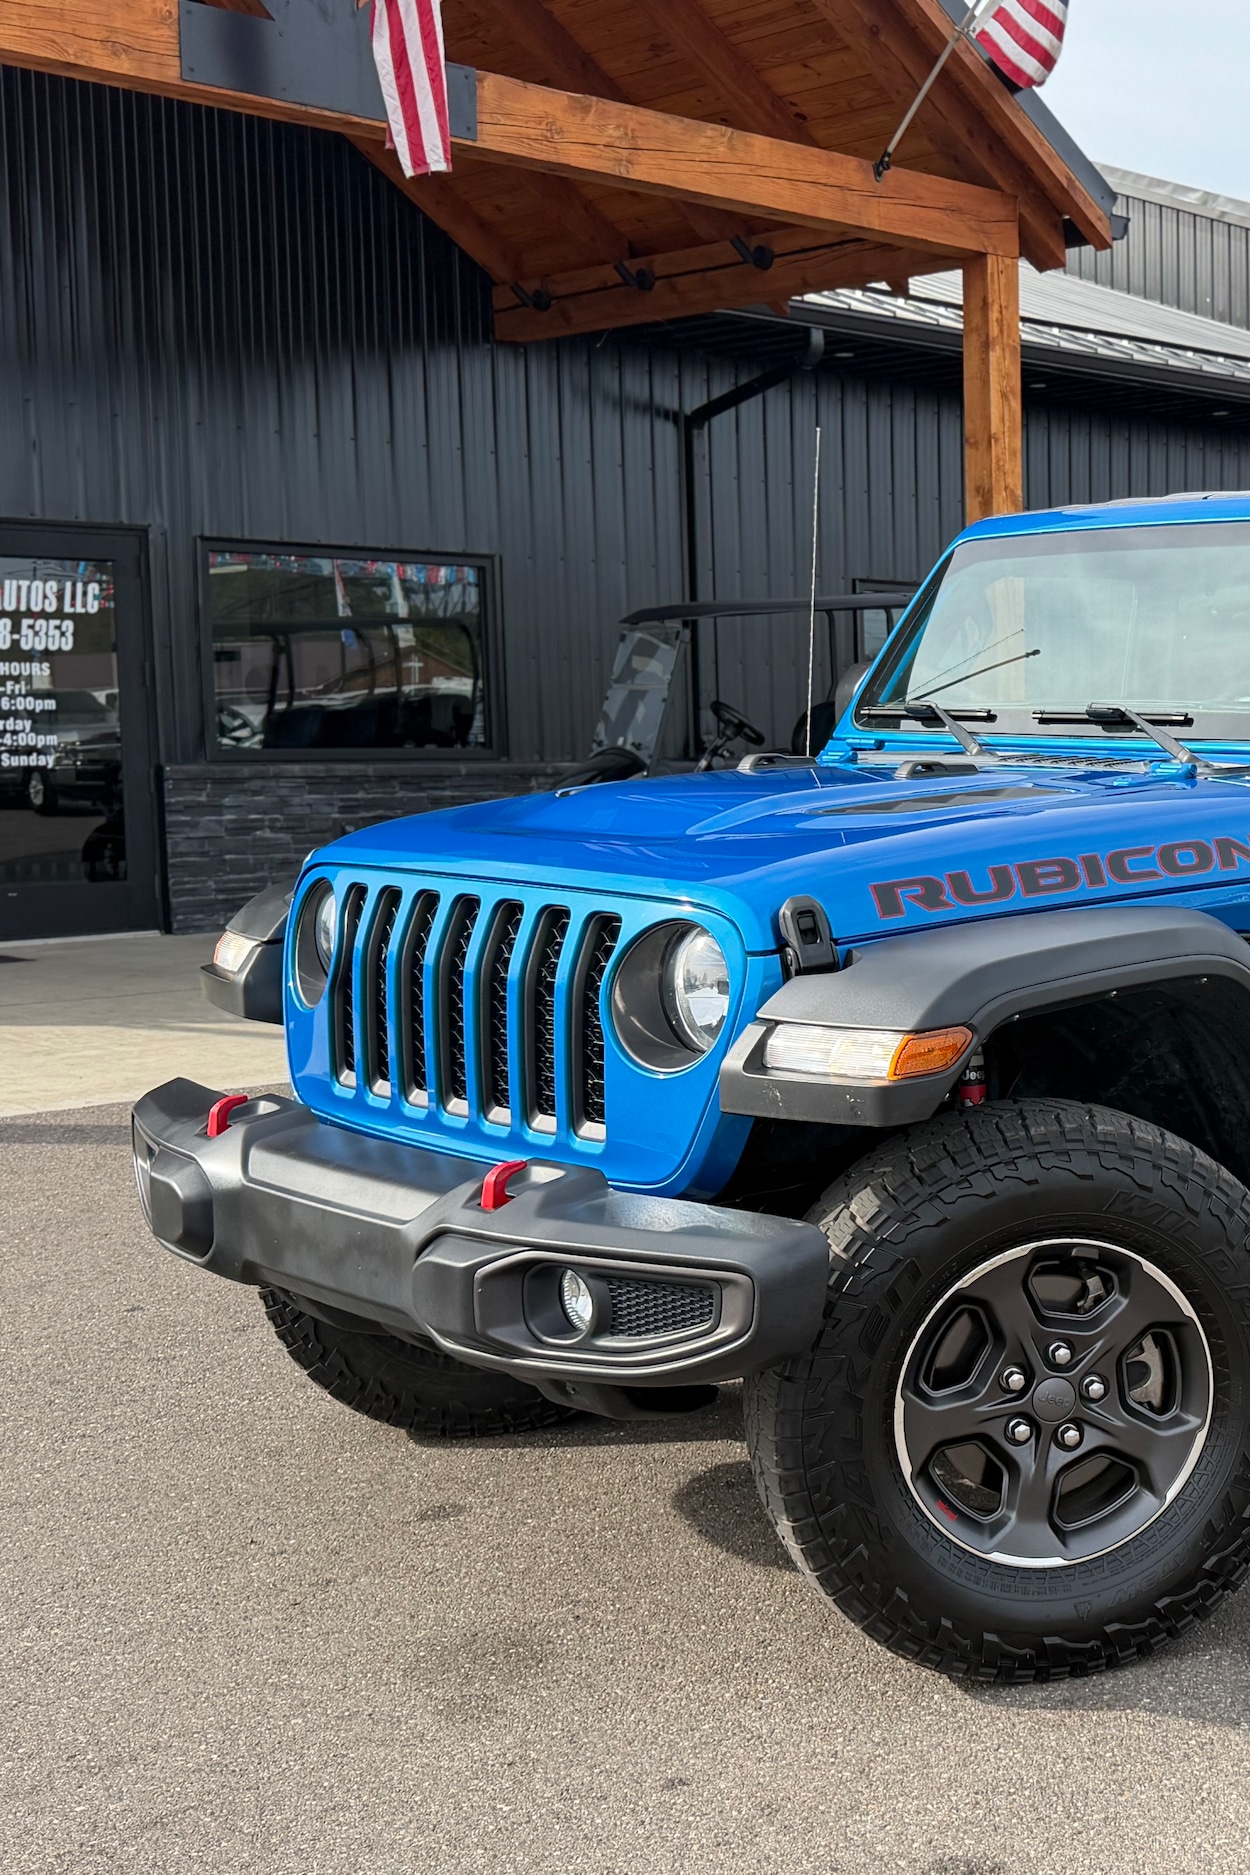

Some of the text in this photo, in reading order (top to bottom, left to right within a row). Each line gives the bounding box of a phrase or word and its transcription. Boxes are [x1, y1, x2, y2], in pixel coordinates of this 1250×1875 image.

[0, 579, 99, 613] UTOS LLC
[0, 618, 74, 651] 8-5353
[0, 661, 50, 676] HOURS
[1, 696, 57, 713] 6:00pm
[1, 752, 55, 769] Sunday
[1038, 1390, 1070, 1408] Jeep
